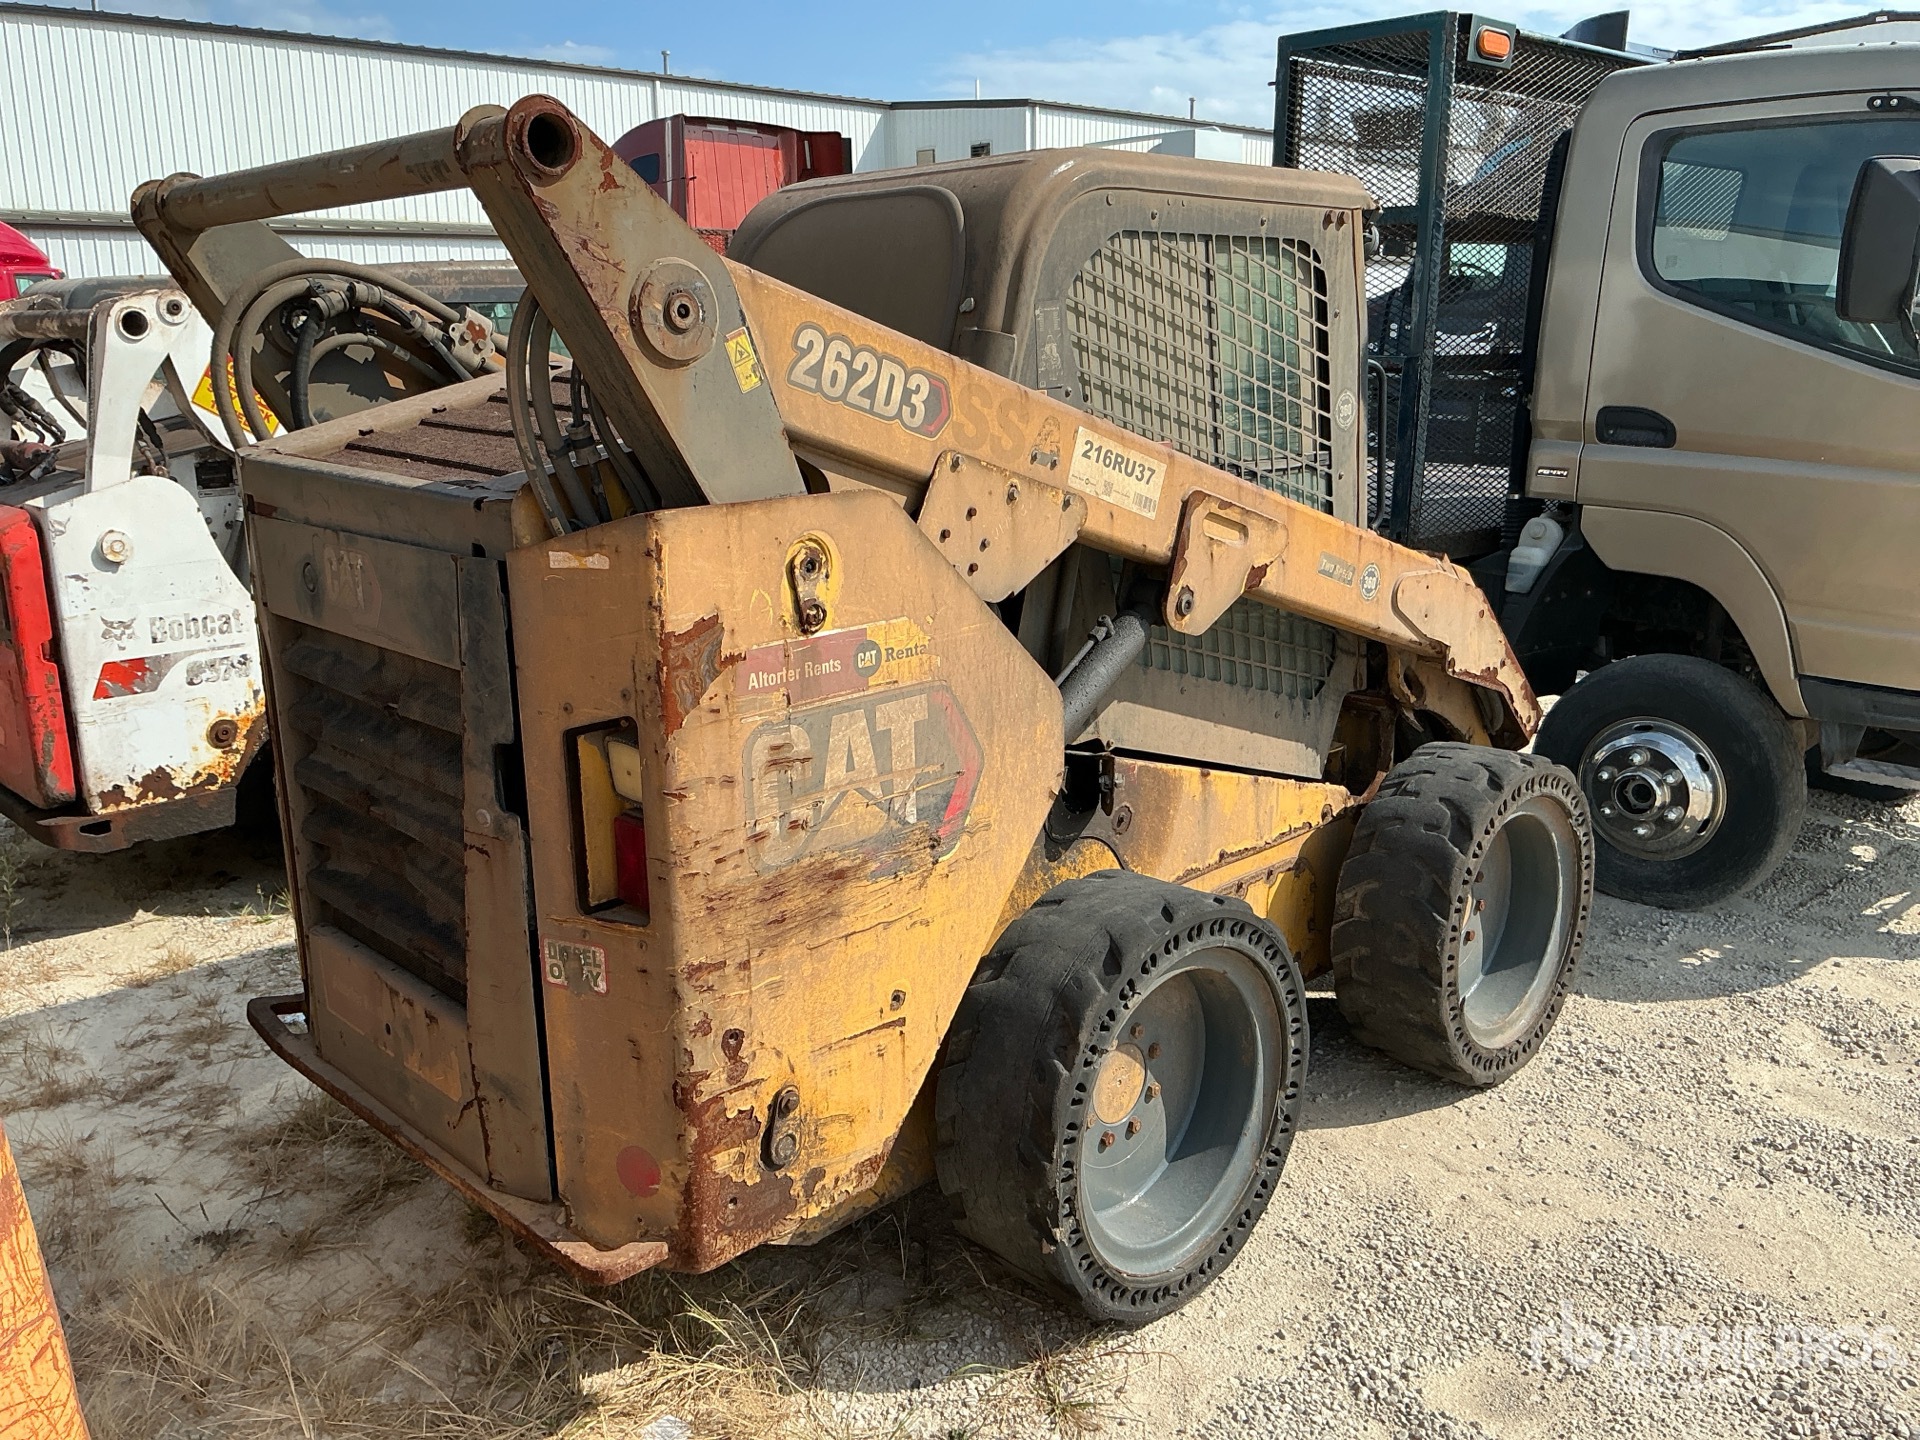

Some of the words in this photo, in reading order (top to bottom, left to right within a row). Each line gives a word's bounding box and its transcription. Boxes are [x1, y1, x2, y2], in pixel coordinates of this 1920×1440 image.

[790, 328, 930, 428] 262D3
[953, 383, 1030, 463] SS
[1081, 439, 1156, 485] 216RU37
[149, 609, 247, 644] Bobcat
[748, 667, 800, 690] Altorfer
[805, 658, 842, 678] Rents
[857, 650, 877, 668] CAT
[751, 694, 929, 866] CAT
